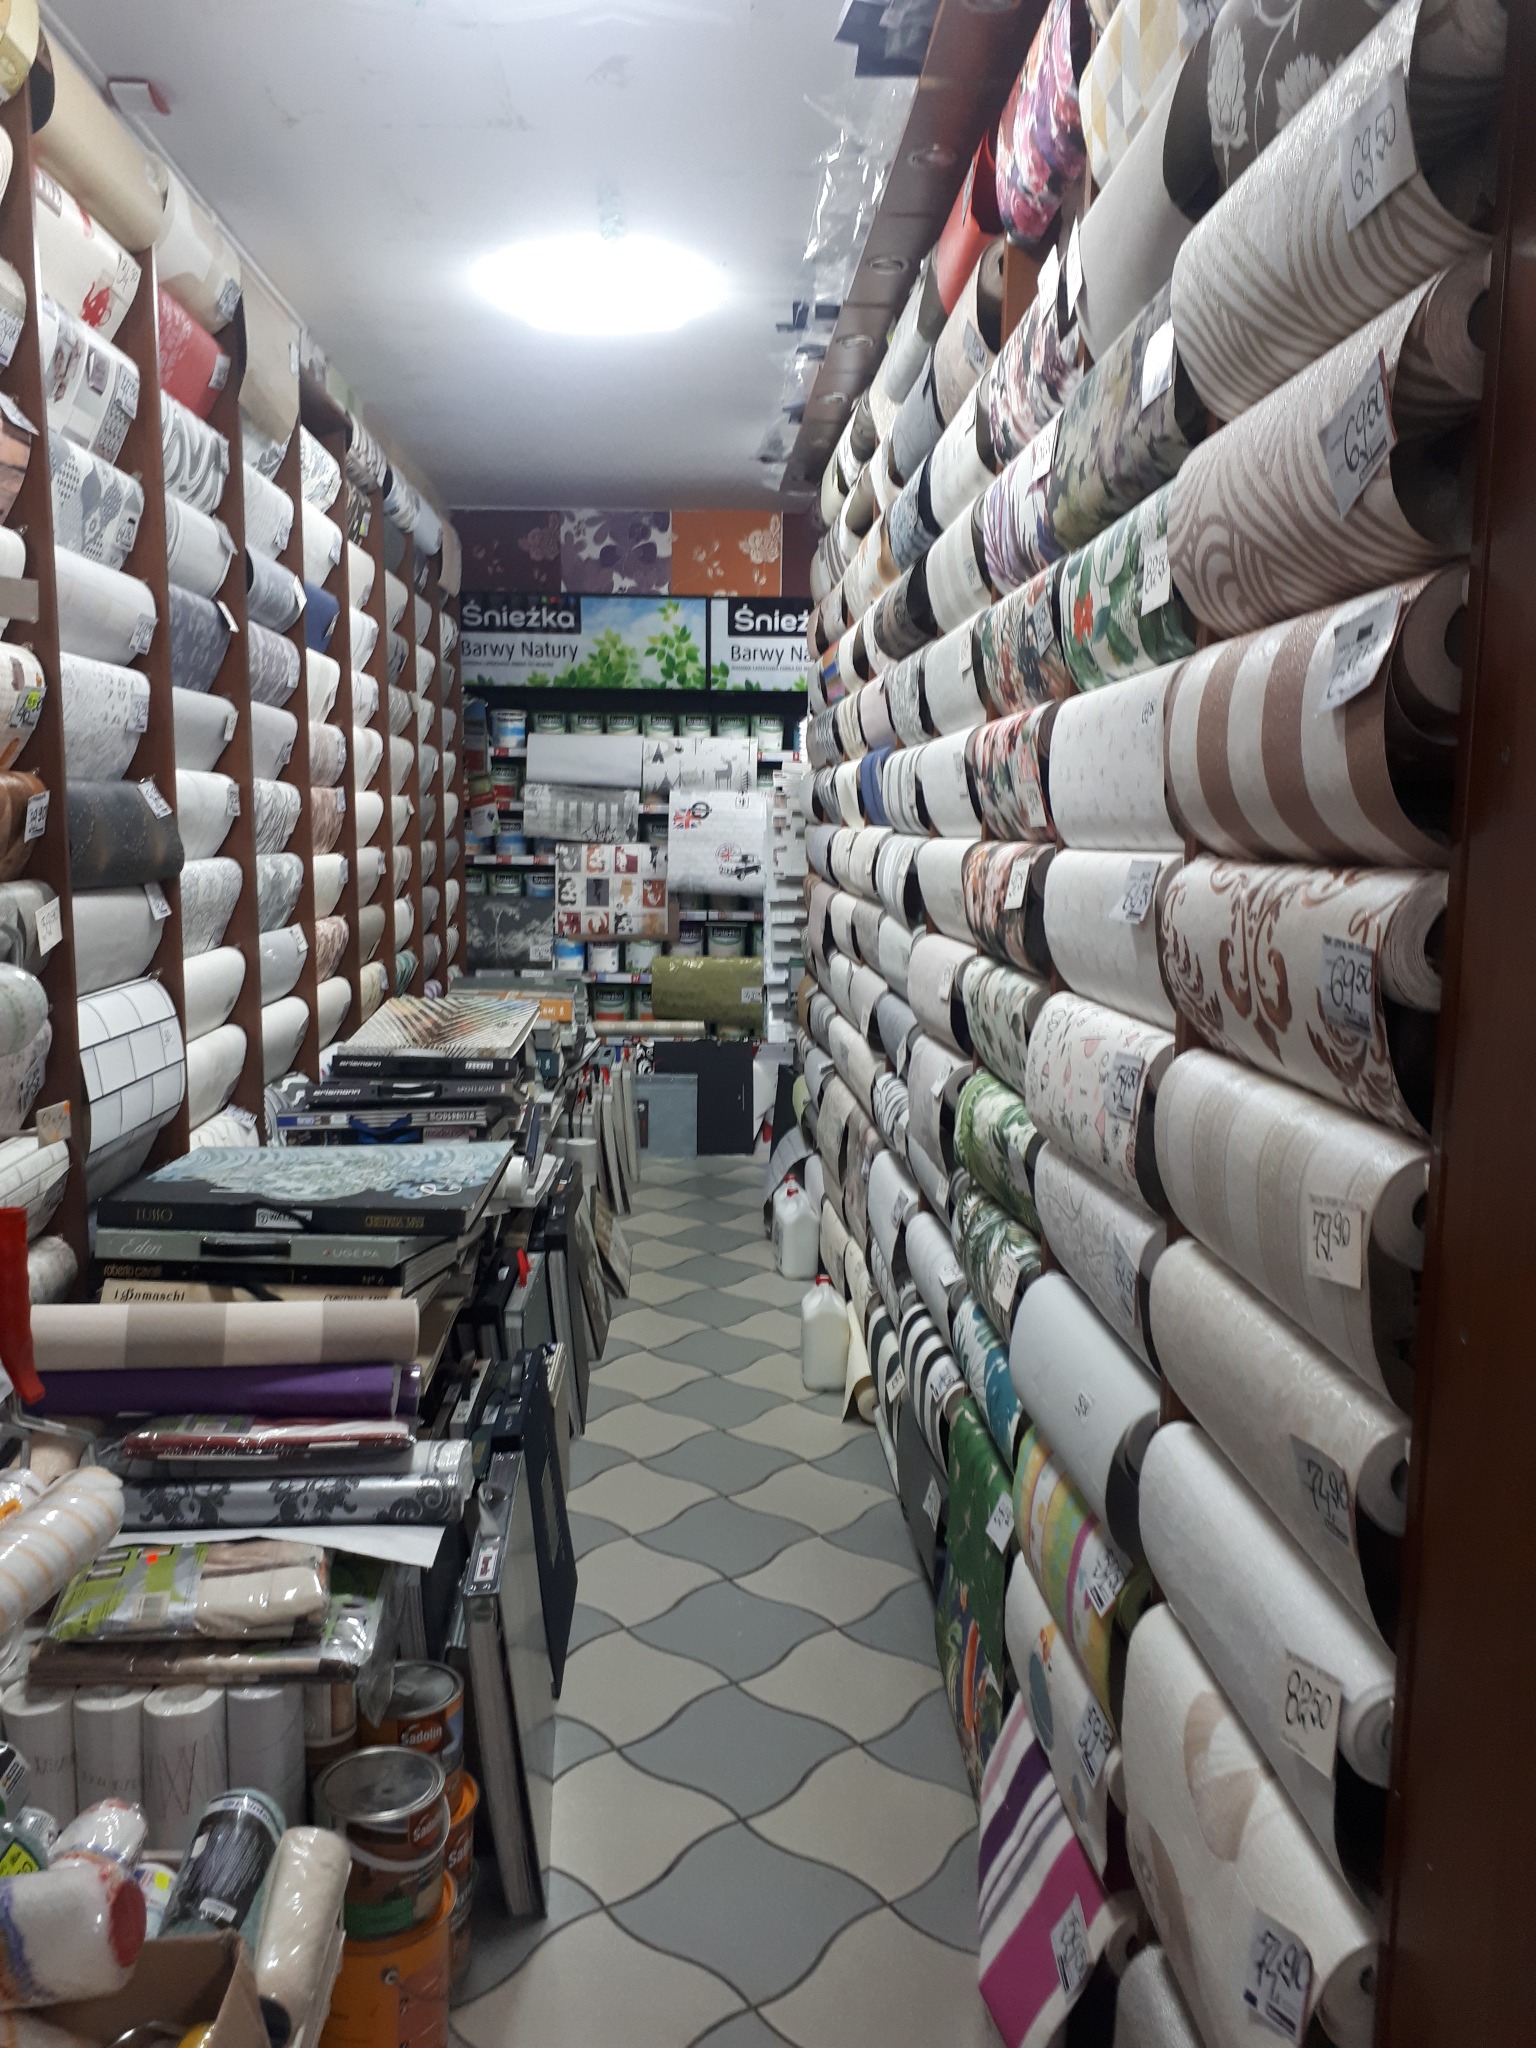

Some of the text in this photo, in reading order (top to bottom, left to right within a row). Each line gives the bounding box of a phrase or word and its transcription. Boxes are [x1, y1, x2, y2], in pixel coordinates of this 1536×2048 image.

[462, 598, 575, 629] Śnieżka
[734, 603, 809, 633] Śnież
[461, 640, 578, 663] Barwy Natury
[731, 645, 784, 667] Barwy
[401, 1724, 443, 1746] Sadolin
